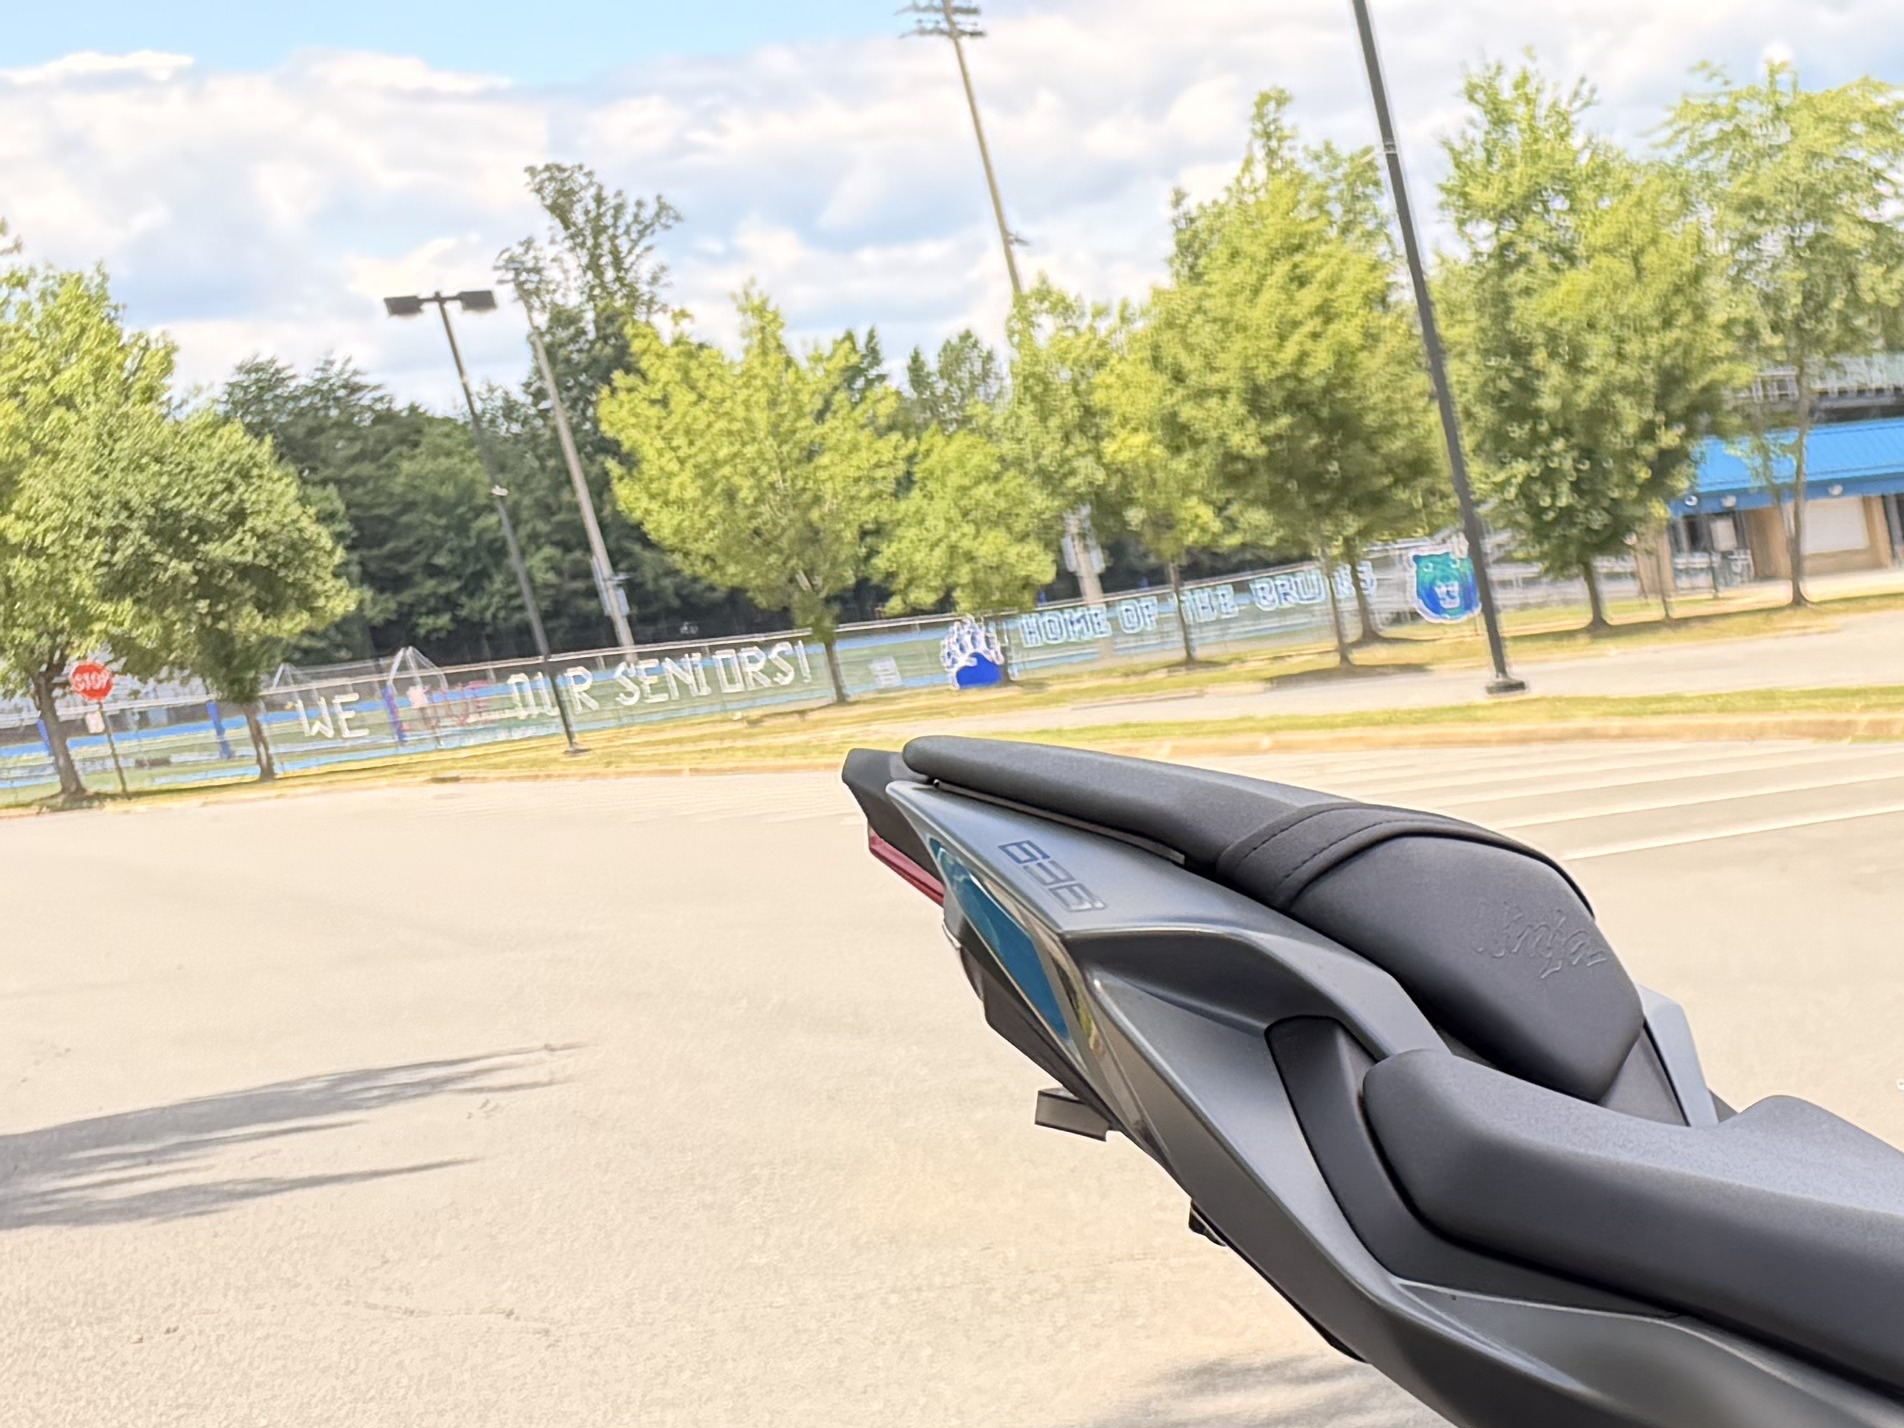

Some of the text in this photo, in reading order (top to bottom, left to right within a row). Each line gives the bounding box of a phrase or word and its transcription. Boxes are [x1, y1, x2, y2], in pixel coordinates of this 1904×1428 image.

[1019, 605, 1112, 647] HOME
[1119, 598, 1158, 634] OF
[1250, 561, 1377, 611] BRUNS
[71, 670, 110, 692] STOP
[296, 692, 370, 738] WE
[613, 639, 812, 706] SENIORS!
[998, 840, 1107, 912] 636
[1474, 900, 1608, 980] Ninja
